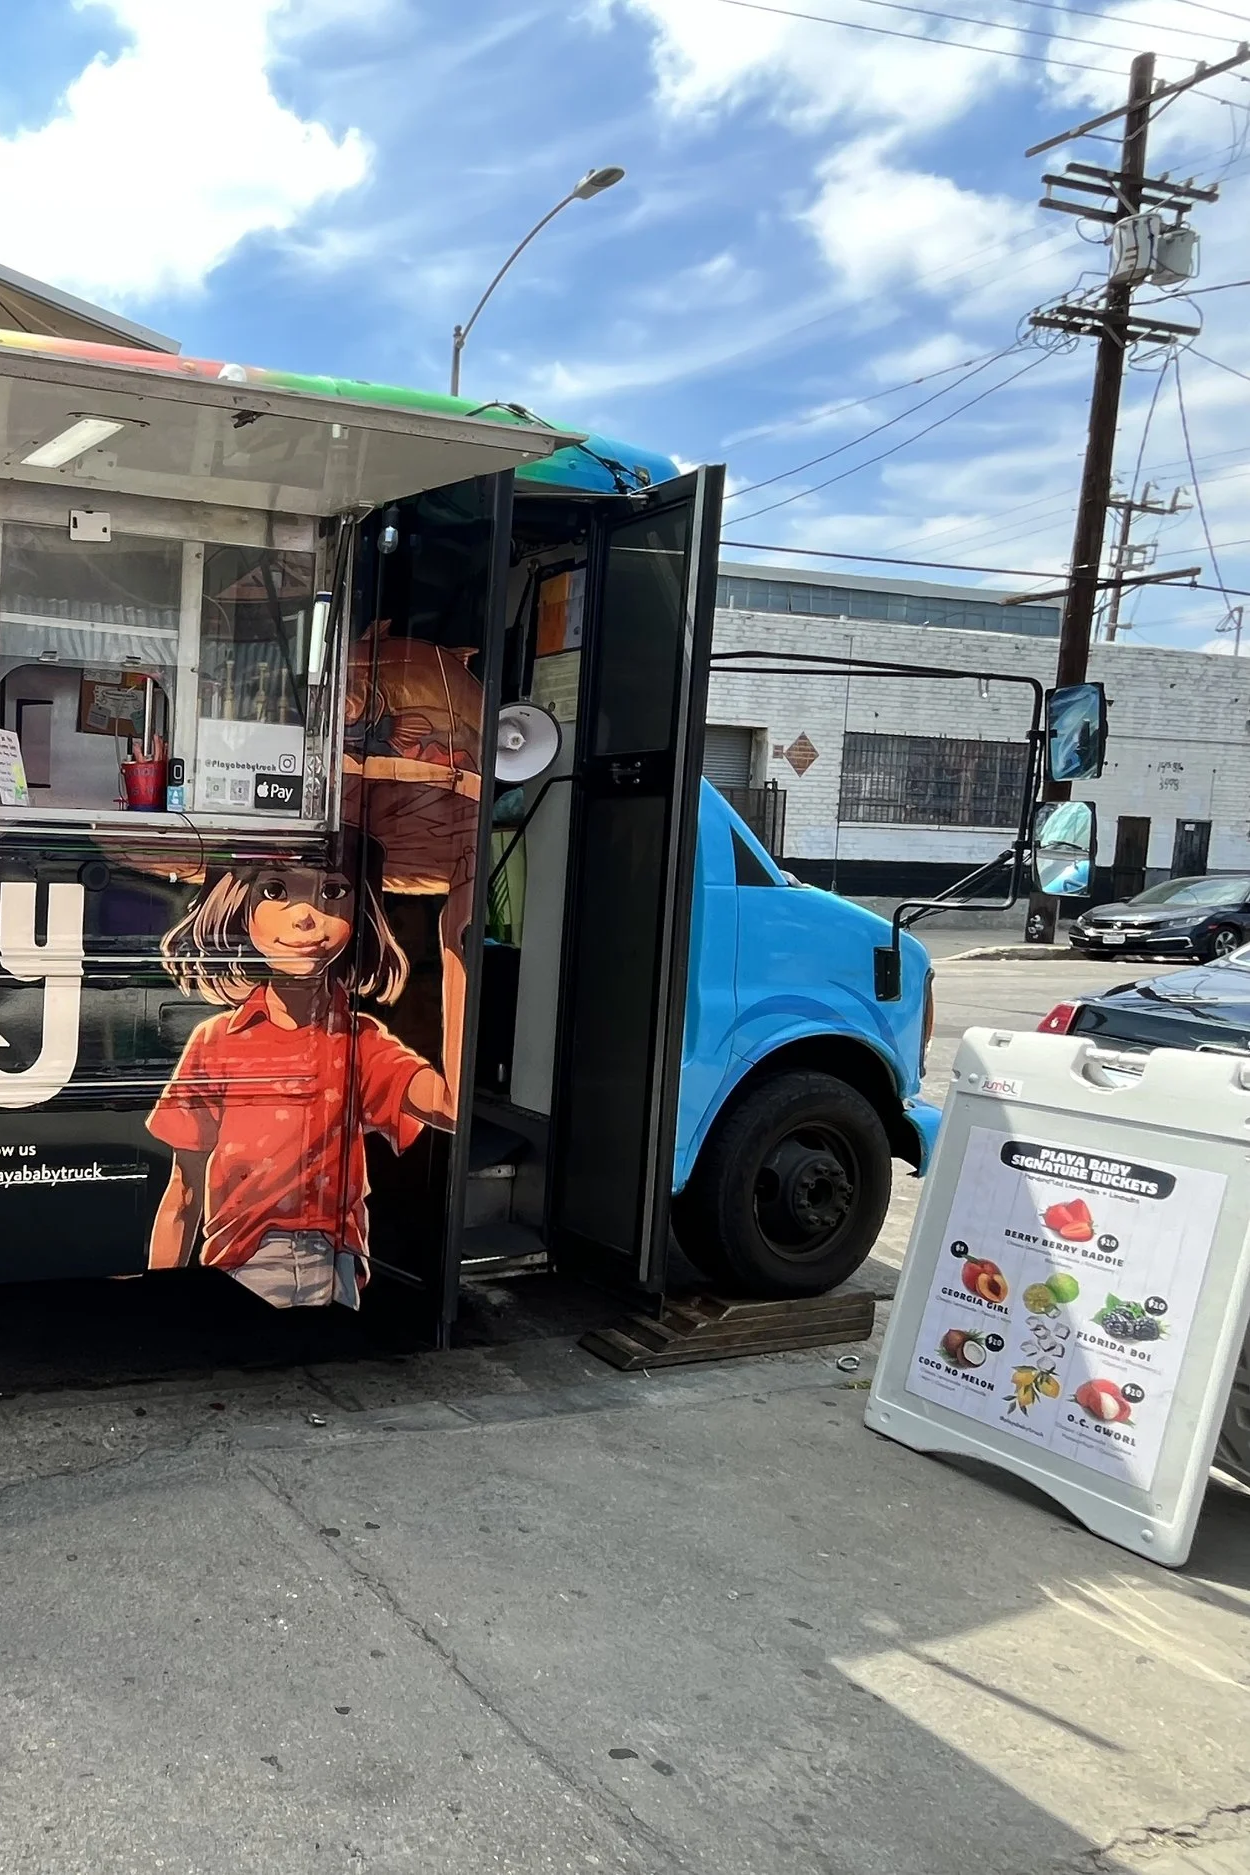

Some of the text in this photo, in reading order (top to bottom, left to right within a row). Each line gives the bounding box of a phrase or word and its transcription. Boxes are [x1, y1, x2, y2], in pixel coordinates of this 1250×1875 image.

[270, 783, 294, 803] Pay
[19, 1143, 37, 1157] us
[1040, 1149, 1131, 1177] PLAYA BABY
[1011, 1154, 1158, 1195] SIGNATURE BUCKETS
[1004, 1229, 1039, 1244] BERRY
[1042, 1238, 1078, 1254] BERRY
[1081, 1249, 1124, 1267] BADDIE
[1100, 1237, 1117, 1247] $10
[941, 1287, 984, 1307] GEORGIA
[986, 1301, 1010, 1315] GIRL
[1148, 1300, 1166, 1311] $10
[1076, 1331, 1125, 1354] FLORIDA
[1130, 1348, 1152, 1362] BOI
[918, 1356, 942, 1370] COCO
[944, 1366, 958, 1377] NO
[961, 1373, 995, 1391] MELON
[1124, 1385, 1142, 1398] $10
[1067, 1414, 1089, 1429] O.C.
[1094, 1424, 1137, 1447] GWORL
